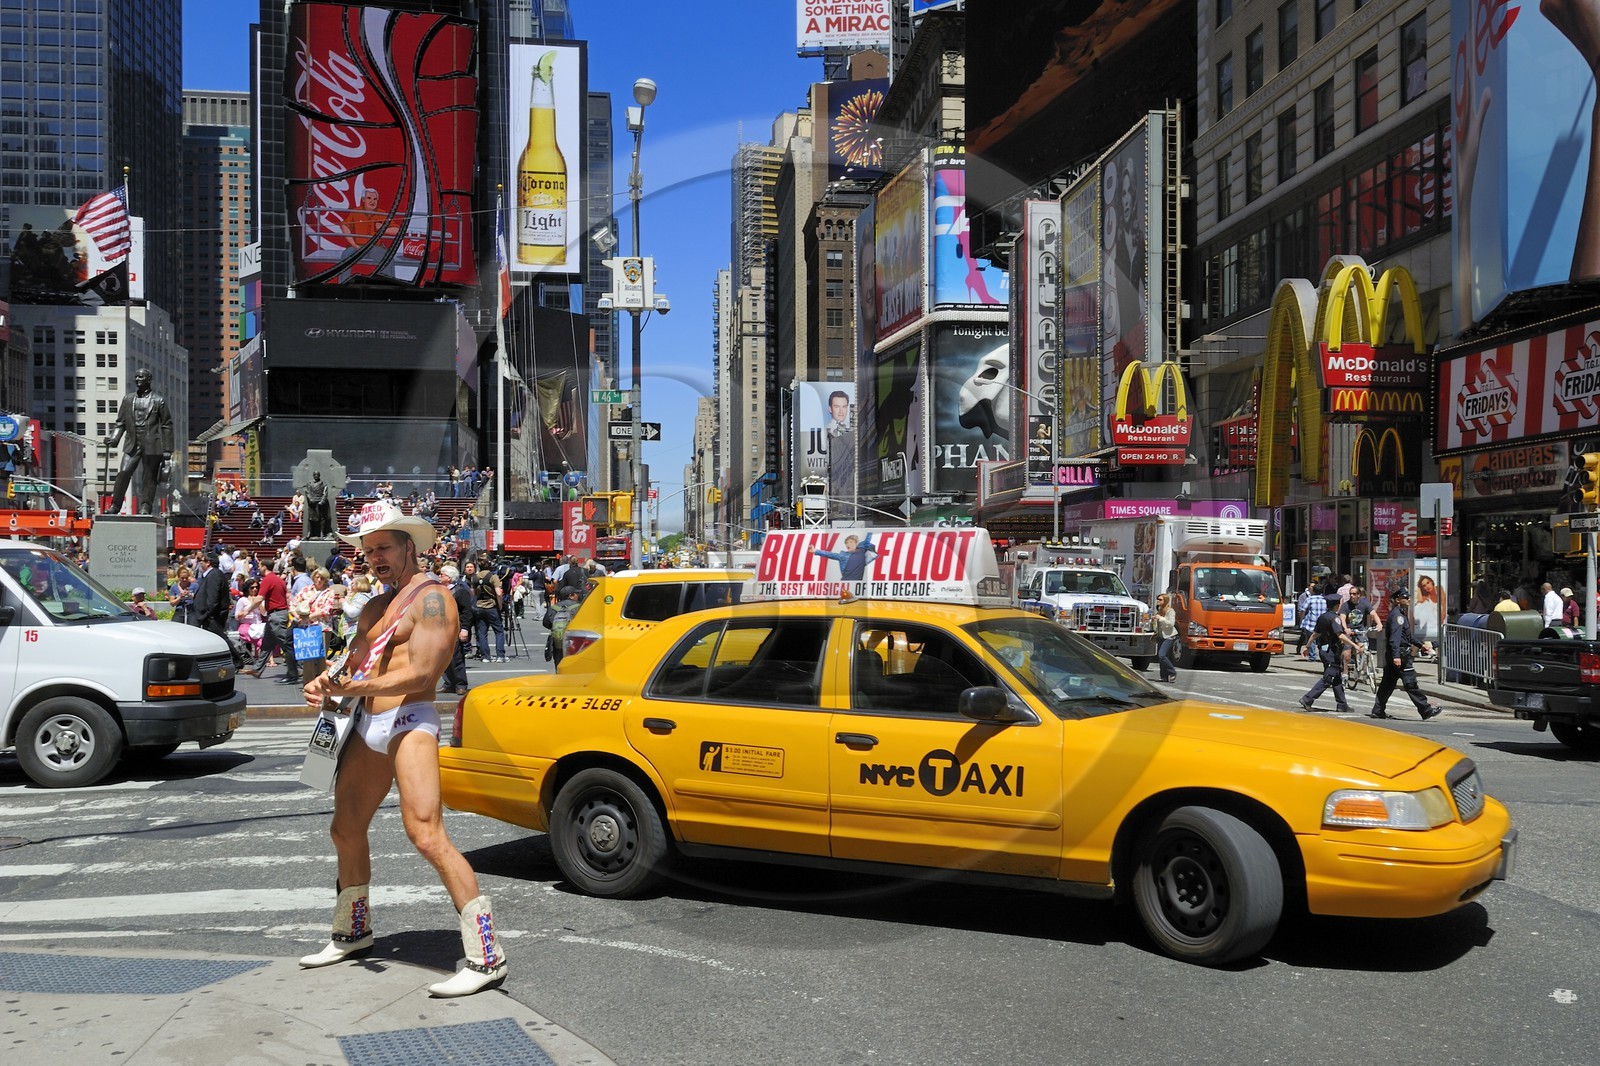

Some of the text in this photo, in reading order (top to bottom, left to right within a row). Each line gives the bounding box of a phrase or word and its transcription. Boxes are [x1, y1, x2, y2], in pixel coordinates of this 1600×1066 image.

[805, 4, 884, 17] SOMETHING
[805, 14, 889, 34] A MIRAC
[522, 175, 565, 192] Corona
[524, 210, 562, 231] Light
[326, 329, 377, 339] HYUNDAI
[952, 325, 993, 340] Tonight
[1327, 356, 1427, 373] McDonald's
[1345, 373, 1411, 383] Restaurant
[593, 391, 599, 402] W
[602, 391, 612, 402] 46
[615, 427, 632, 436] ONE
[1116, 423, 1188, 435] McDonald's
[1156, 453, 1183, 461] HOR
[1110, 506, 1171, 515] TIMES SQUARE
[1573, 519, 1585, 527] ONE
[757, 533, 840, 582] BILLY
[872, 531, 977, 582] ELLIOT
[780, 582, 805, 595] BEST
[855, 582, 867, 596] OF
[871, 582, 891, 596] THE
[25, 629, 38, 642] 15
[302, 629, 317, 639] Met
[296, 648, 320, 660] of Art
[581, 697, 623, 711] 3L88
[393, 713, 419, 729] NYC
[766, 750, 780, 758] FARE
[859, 749, 1025, 797] NYC TAXI
